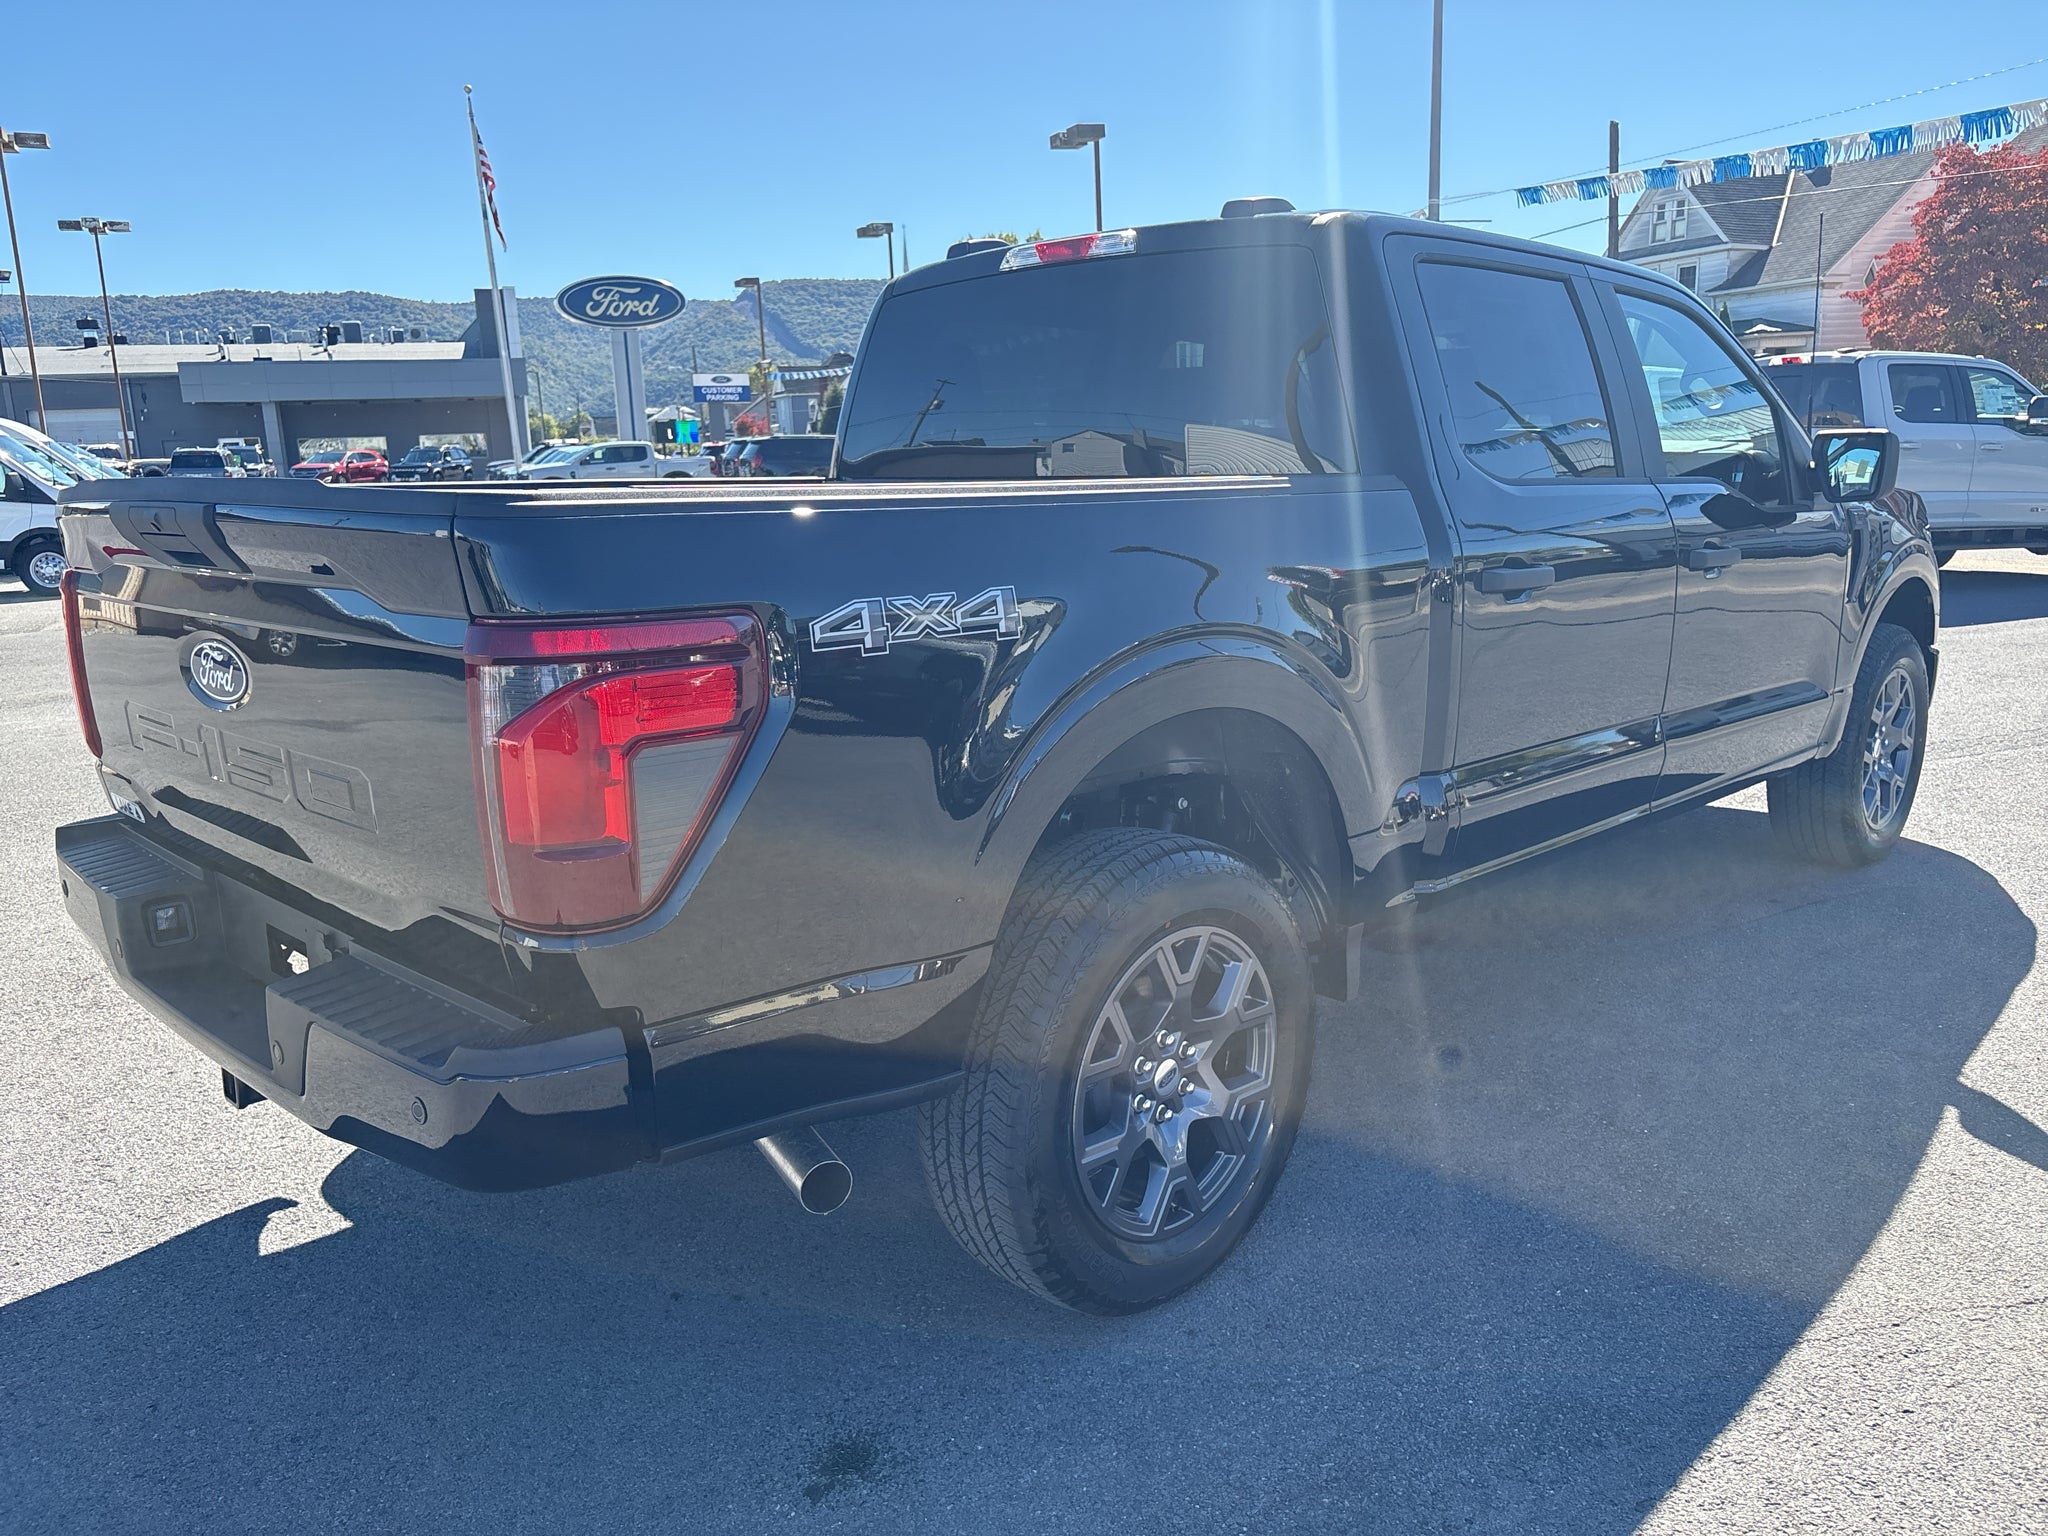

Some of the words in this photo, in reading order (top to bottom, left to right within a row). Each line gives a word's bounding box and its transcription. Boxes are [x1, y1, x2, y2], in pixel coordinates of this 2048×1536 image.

[585, 285, 661, 317] Ford
[200, 646, 235, 692] Ford
[124, 699, 378, 834] F-150
